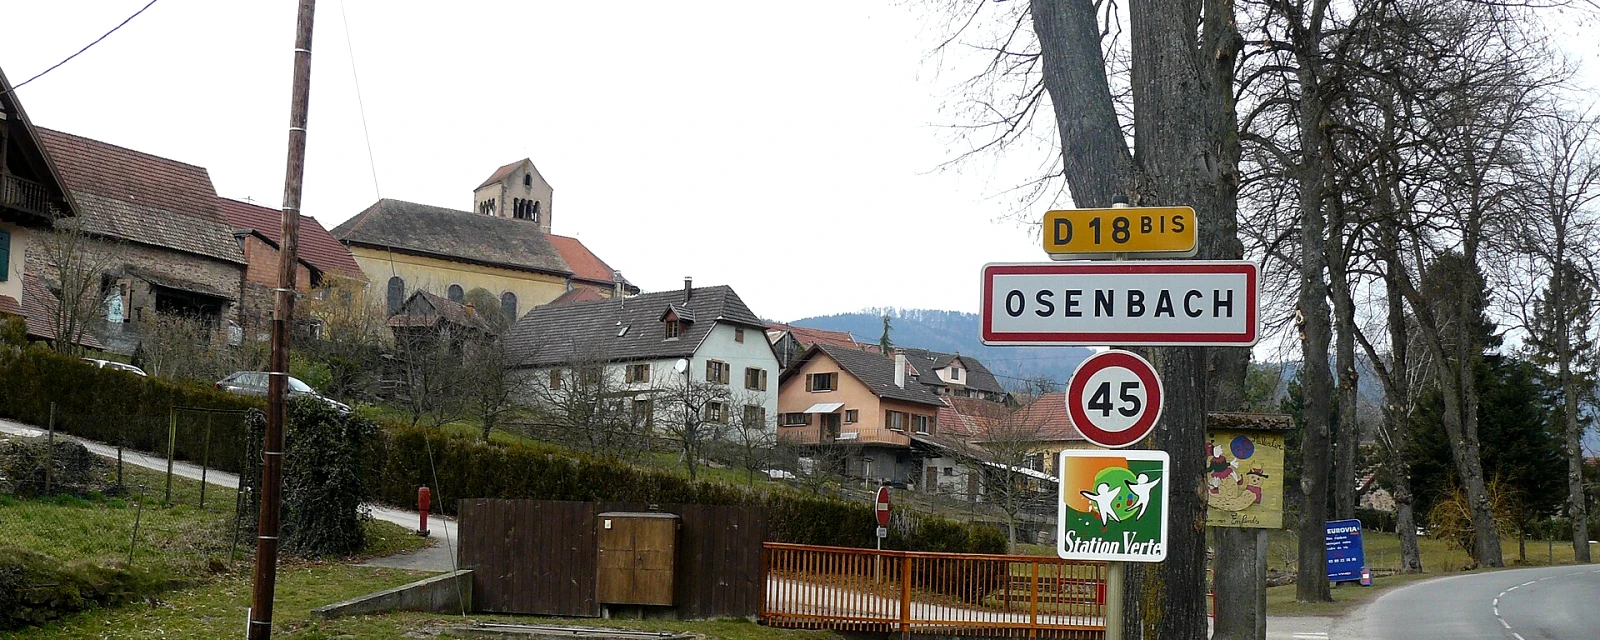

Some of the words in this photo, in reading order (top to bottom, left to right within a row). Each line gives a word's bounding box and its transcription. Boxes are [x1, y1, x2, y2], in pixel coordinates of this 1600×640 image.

[1053, 218, 1073, 245] D
[1088, 216, 1131, 245] 18
[1140, 215, 1185, 234] BIS
[1005, 289, 1233, 318] OSENBACH
[1087, 381, 1142, 417] 45
[1064, 530, 1119, 555] Station
[1123, 531, 1161, 556] Verte
[1327, 526, 1357, 534] EUROVIA
